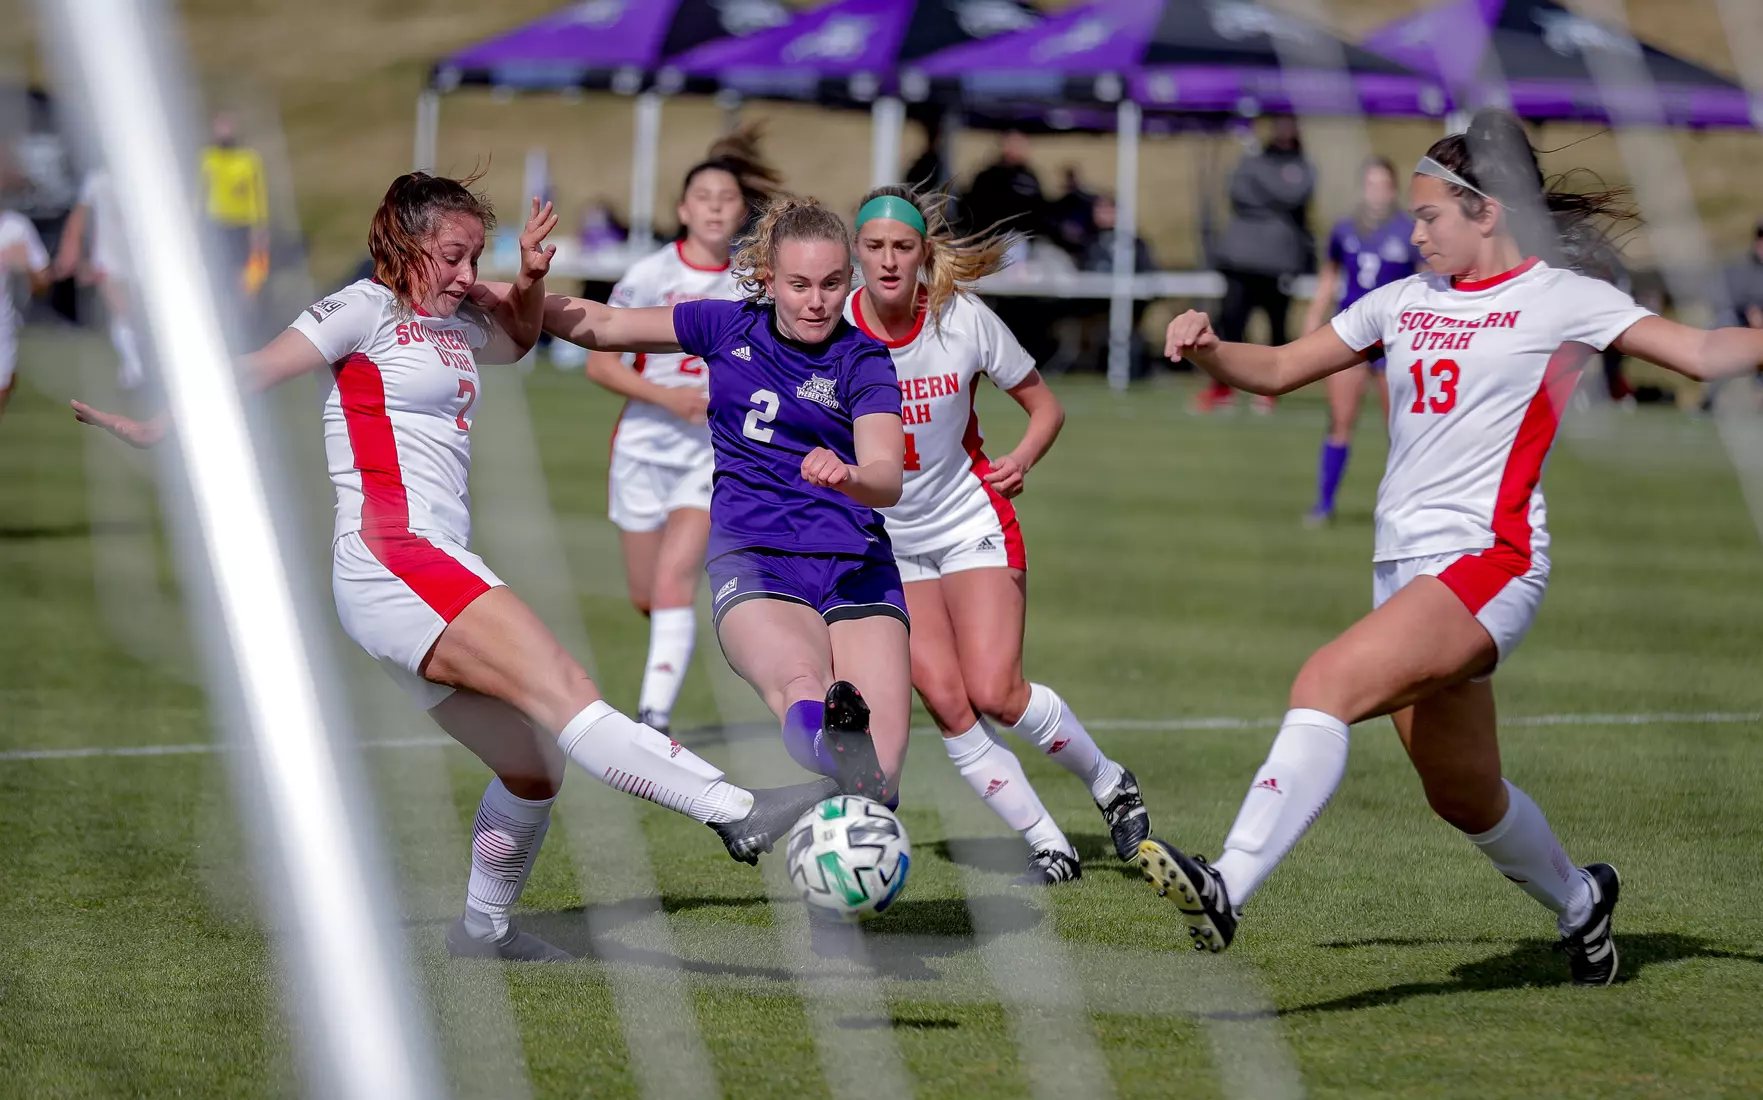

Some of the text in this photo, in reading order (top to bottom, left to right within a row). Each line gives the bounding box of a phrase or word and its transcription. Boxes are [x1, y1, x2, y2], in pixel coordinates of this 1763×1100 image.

[1411, 331, 1477, 352] UTAH
[433, 346, 475, 373] UTAH
[898, 372, 960, 401] HERN
[1409, 358, 1461, 415] 13
[455, 378, 477, 431] 7
[742, 388, 780, 443] 2
[902, 403, 932, 425] AH
